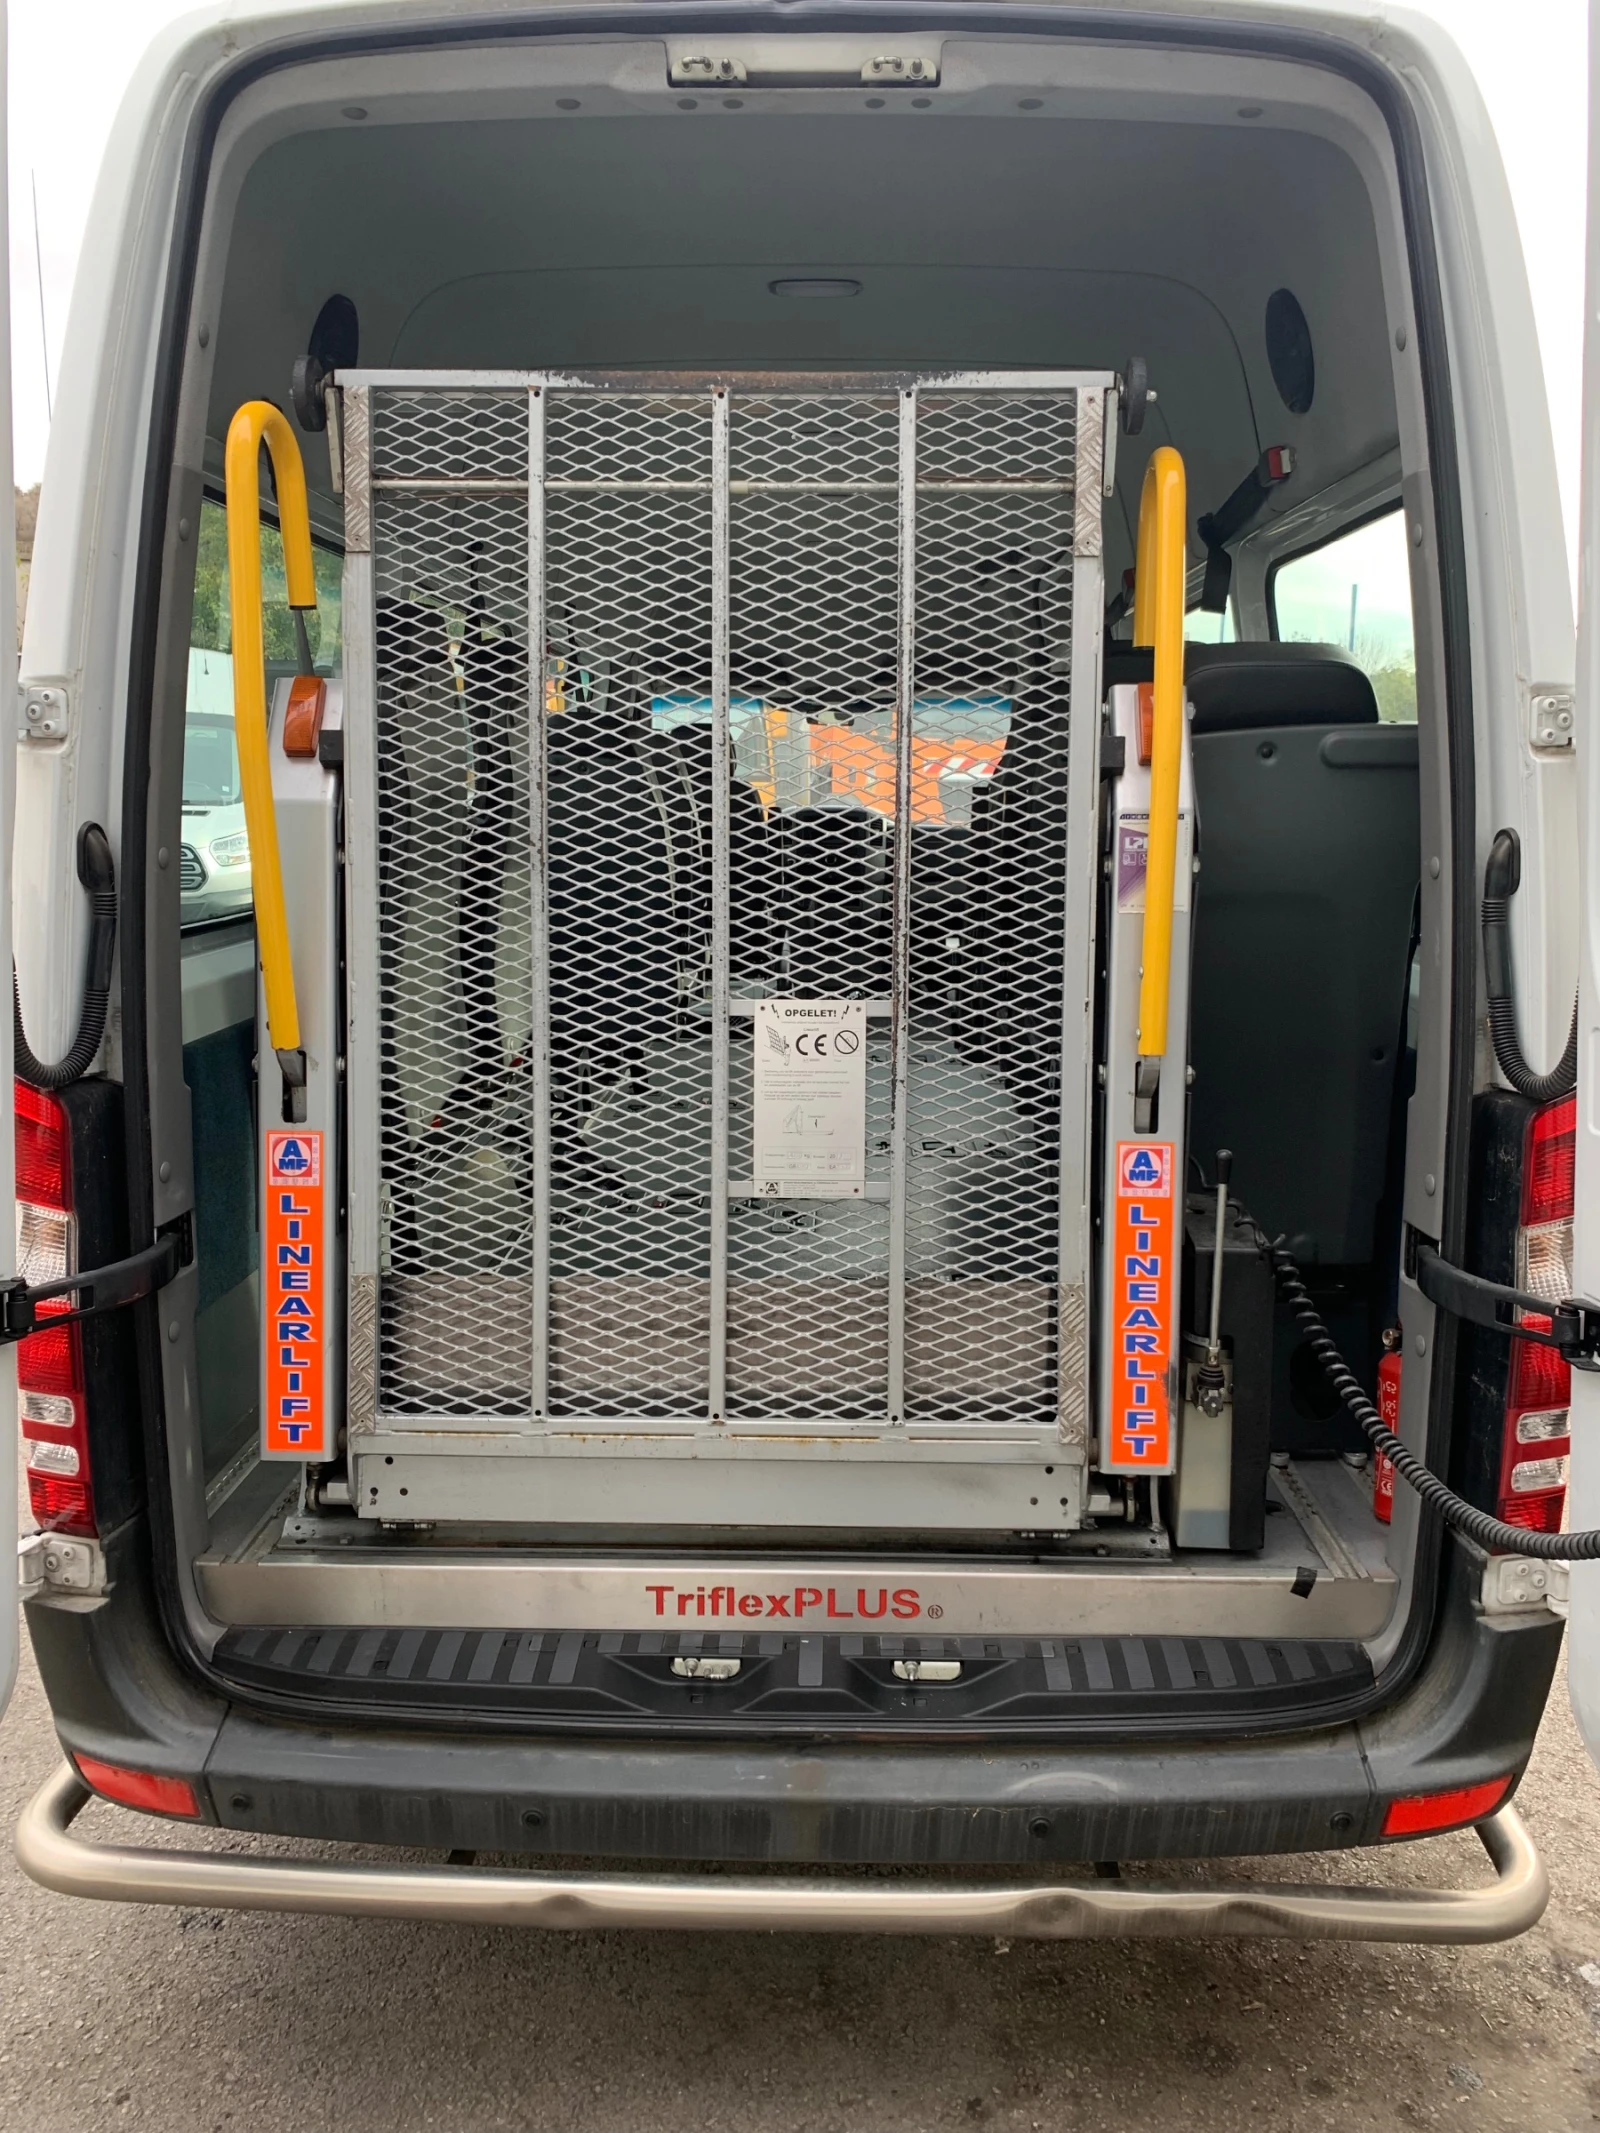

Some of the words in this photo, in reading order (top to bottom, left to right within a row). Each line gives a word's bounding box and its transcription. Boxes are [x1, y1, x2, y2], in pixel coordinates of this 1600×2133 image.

[784, 1008, 837, 1018] OPGELET!
[795, 1033, 828, 1056] CE
[276, 1194, 316, 1442] LINEARLIFT
[1121, 1205, 1162, 1455] LINEARLIFT
[645, 1585, 921, 1619] TriflexPLUS
